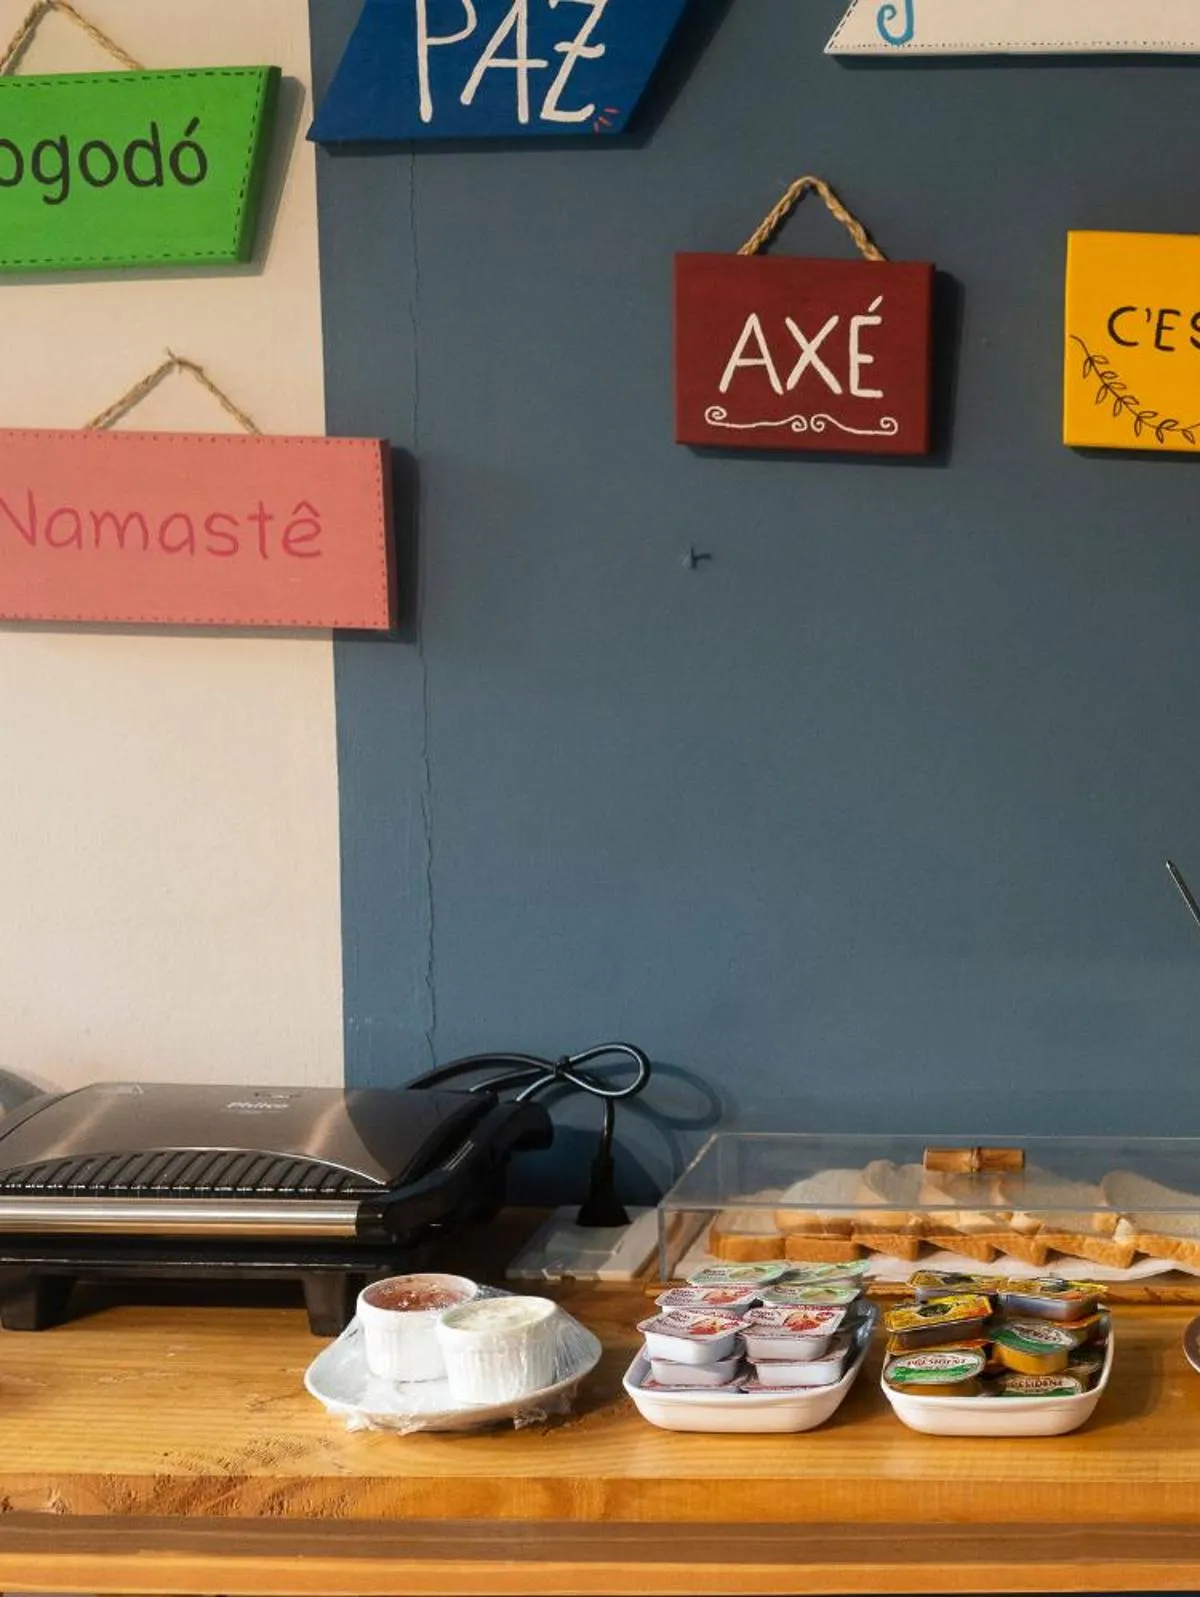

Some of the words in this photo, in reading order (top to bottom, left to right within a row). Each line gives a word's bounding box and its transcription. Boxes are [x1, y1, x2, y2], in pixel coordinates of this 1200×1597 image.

[415, 0, 607, 124] PAZ
[718, 295, 884, 398] AXÉ
[0, 487, 323, 560] Namastê
